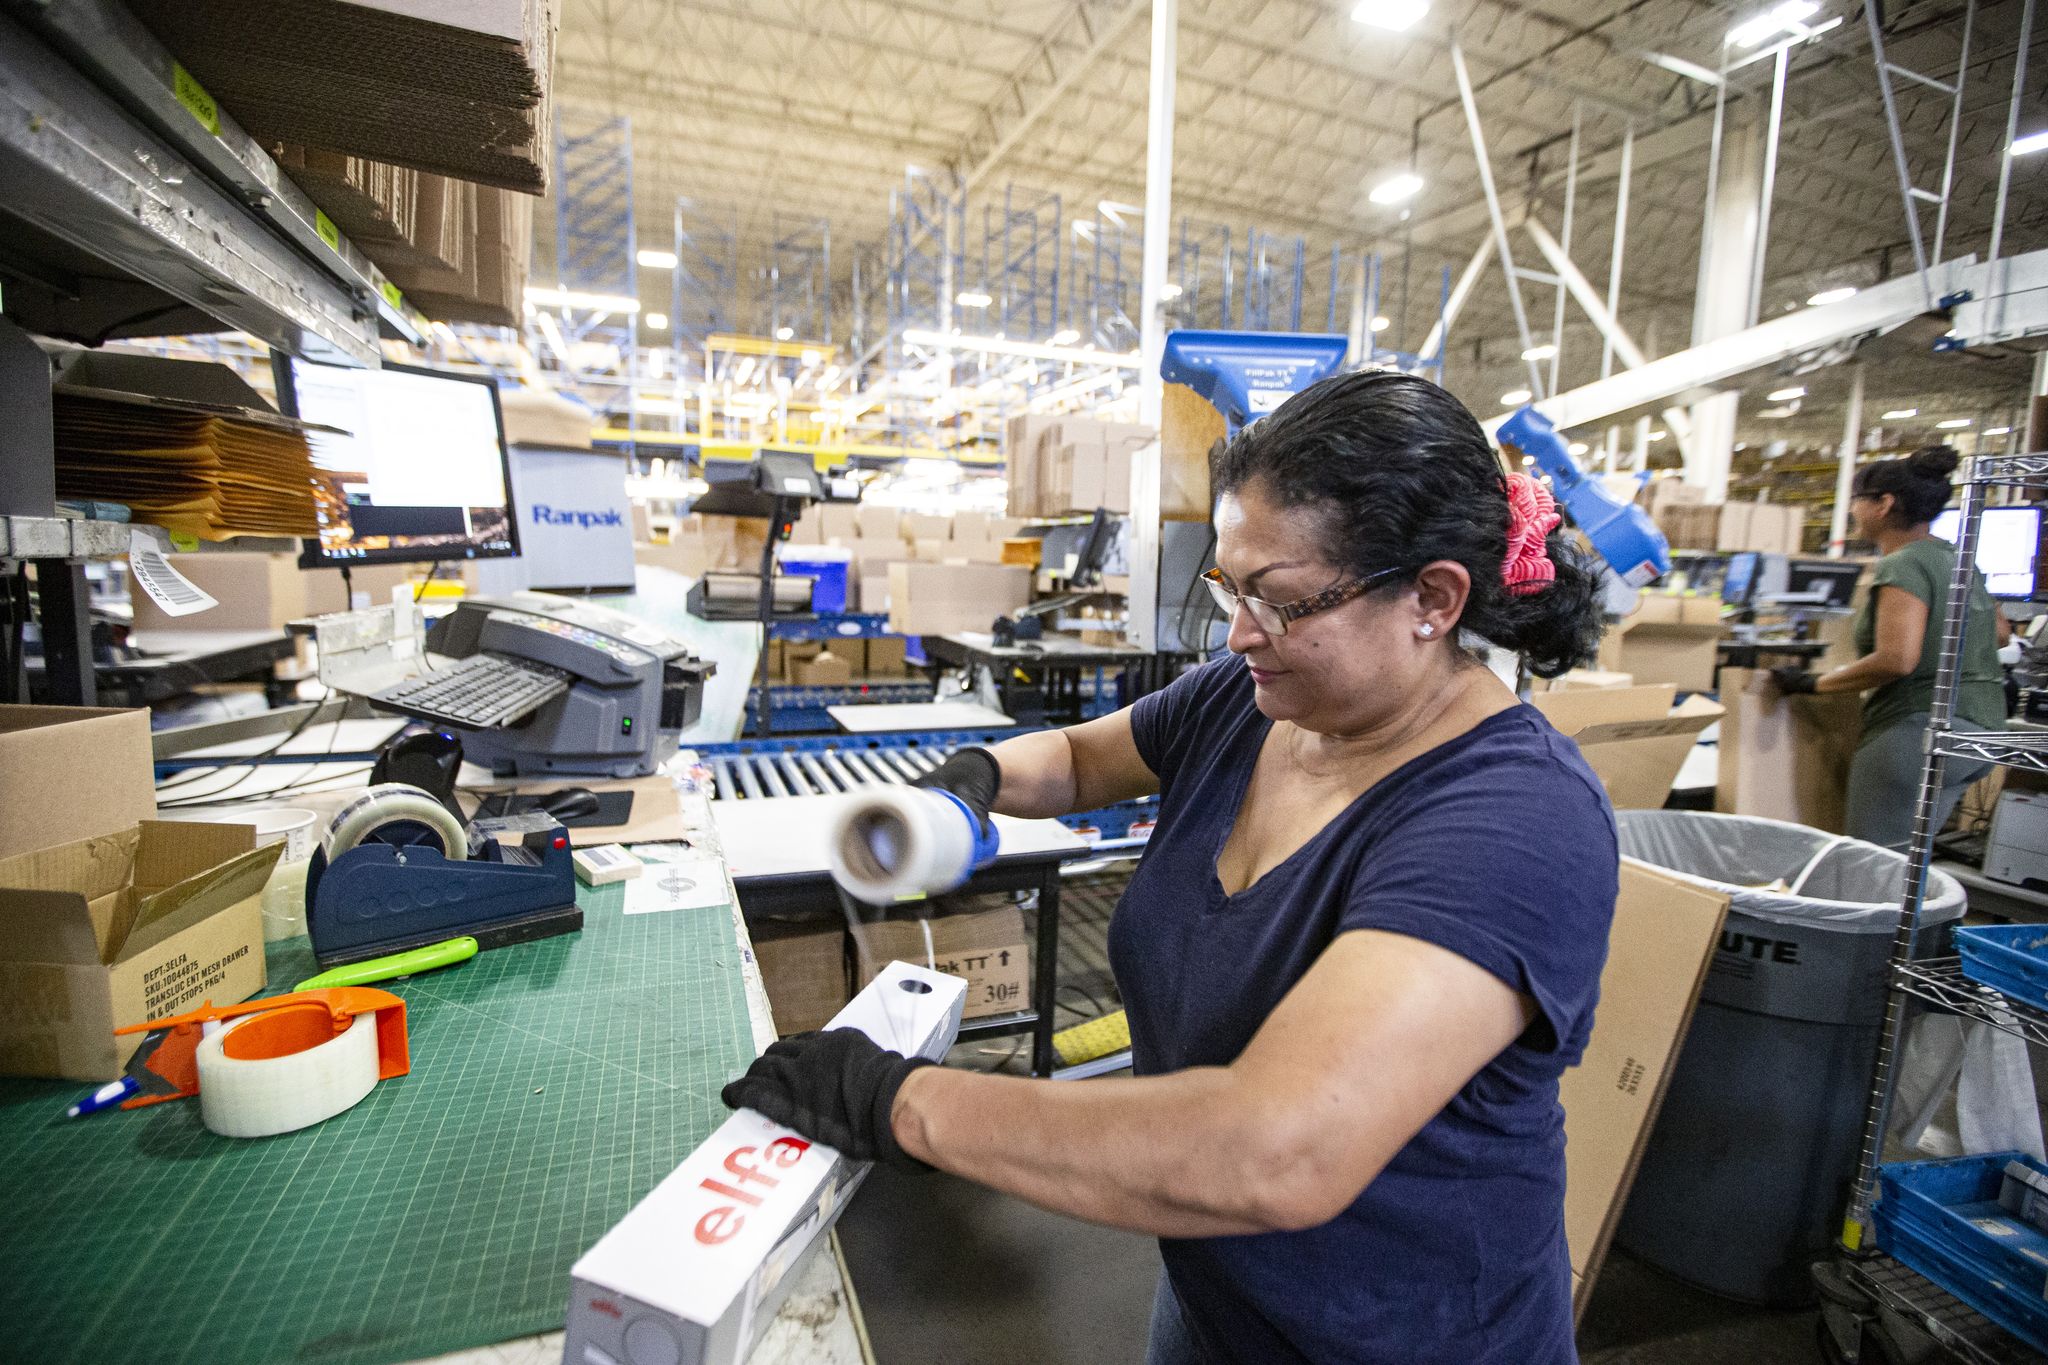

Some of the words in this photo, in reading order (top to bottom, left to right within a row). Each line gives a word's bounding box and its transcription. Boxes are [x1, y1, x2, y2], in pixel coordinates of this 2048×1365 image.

[532, 503, 624, 530] Ranpak
[144, 953, 187, 984] DEPT:3ELFA
[144, 960, 199, 997] SKU:10044875
[201, 961, 221, 979] MESH
[222, 945, 249, 967] DRAWER
[147, 1010, 156, 1022] IN
[157, 1006, 163, 1017] &
[165, 997, 180, 1013] OUT
[181, 983, 203, 1004] STOPS
[205, 971, 225, 990] PKG/4
[984, 981, 1019, 1003] 30#
[694, 1136, 812, 1245] elfa
